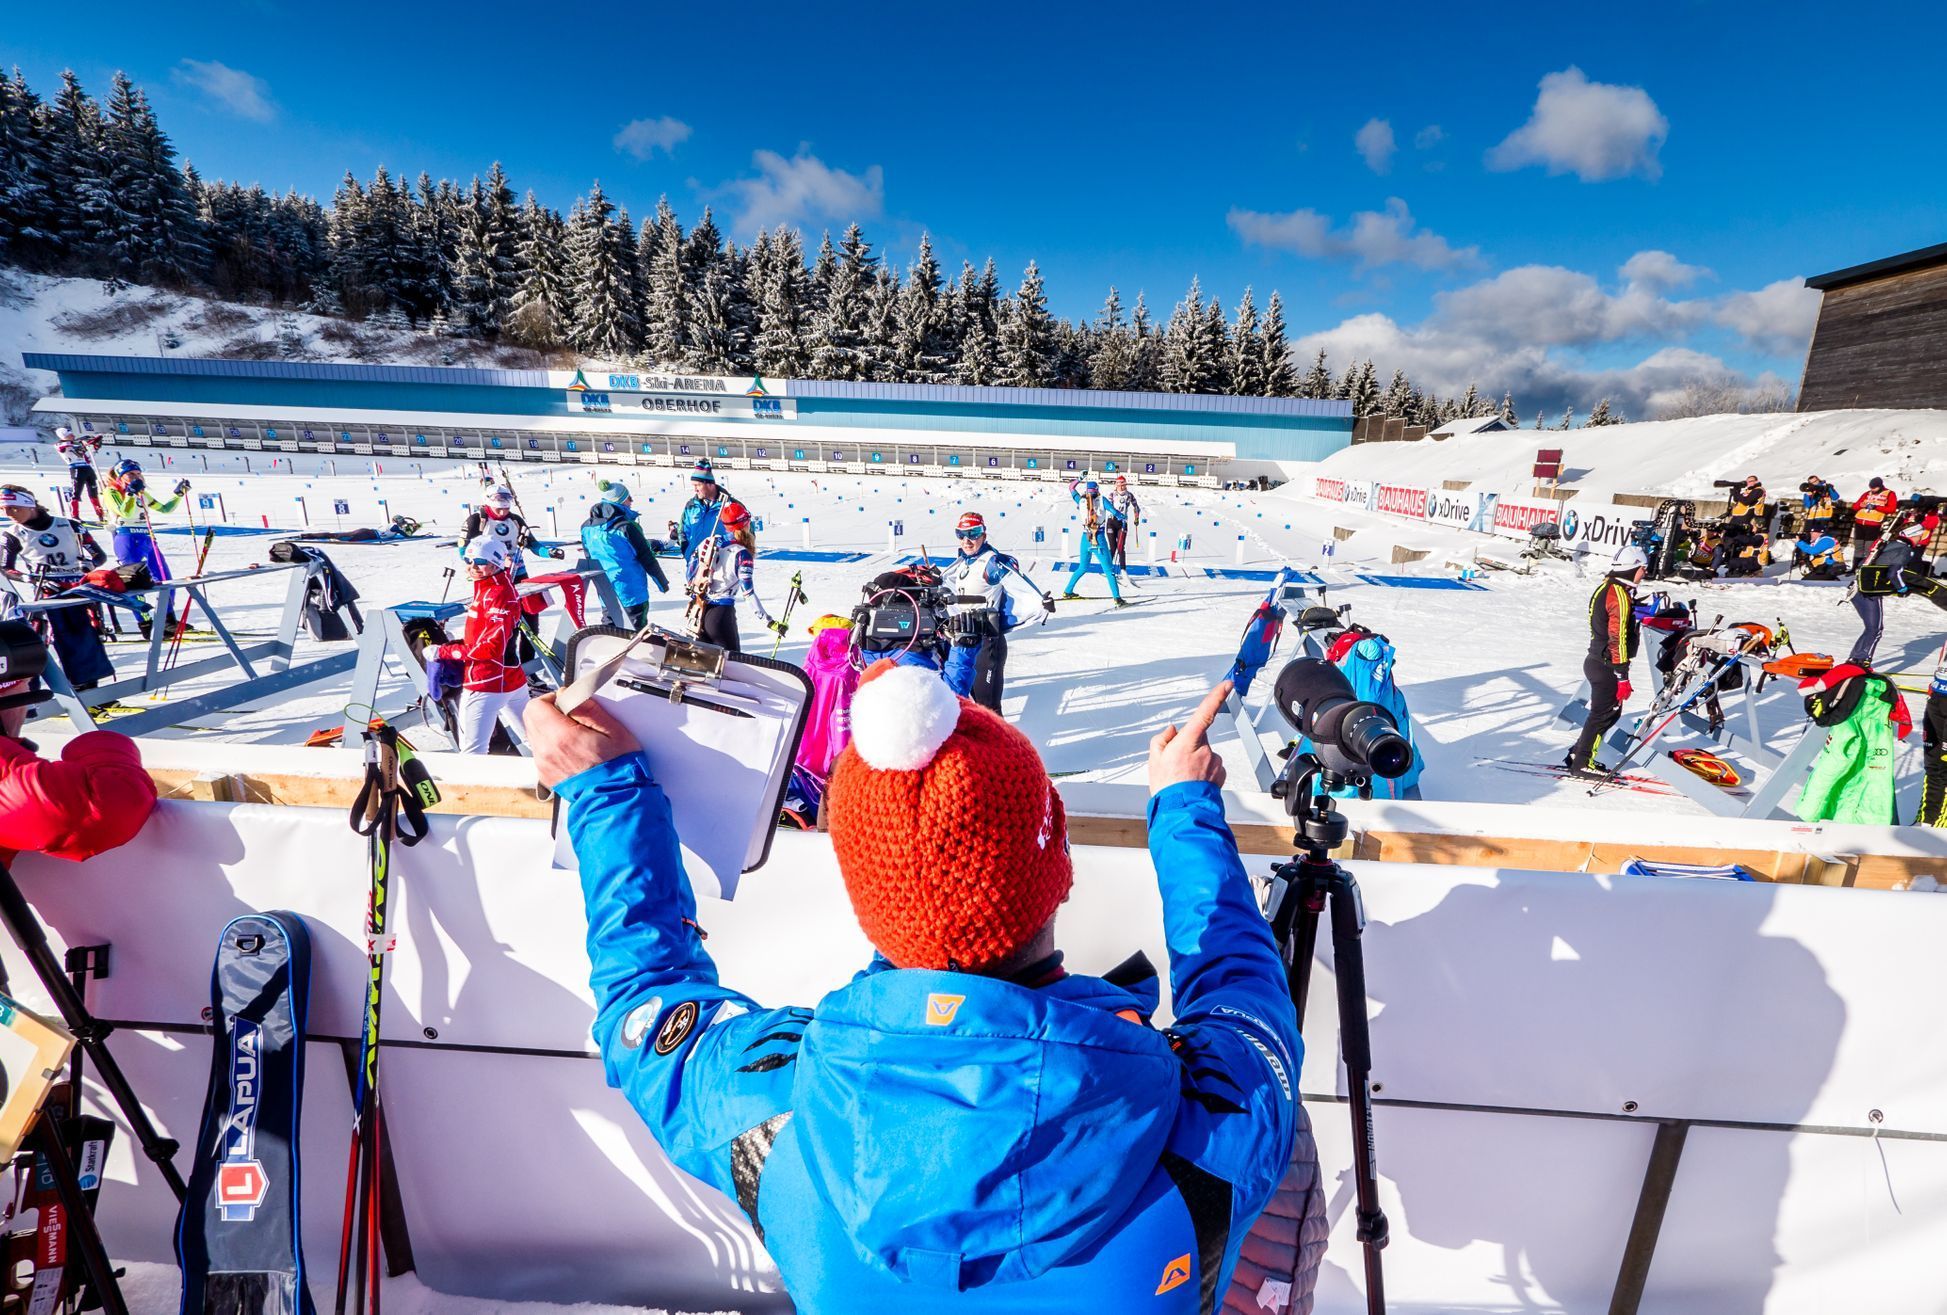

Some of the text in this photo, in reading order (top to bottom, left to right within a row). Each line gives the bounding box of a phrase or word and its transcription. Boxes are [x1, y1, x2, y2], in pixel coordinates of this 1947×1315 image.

[581, 393, 609, 406] DKB
[641, 398, 721, 413] OBERHOF
[753, 399, 781, 412] DKB
[202, 499, 210, 509] 9
[338, 504, 346, 514] 8
[1378, 486, 1426, 517] BAUHAUS
[1438, 497, 1470, 521] xDrive
[1582, 515, 1633, 547] xDriv
[229, 1029, 258, 1156] LAPUA
[84, 1140, 98, 1172] Statkraft
[227, 1173, 252, 1195] L
[43, 1205, 61, 1264] VIESSMANN
